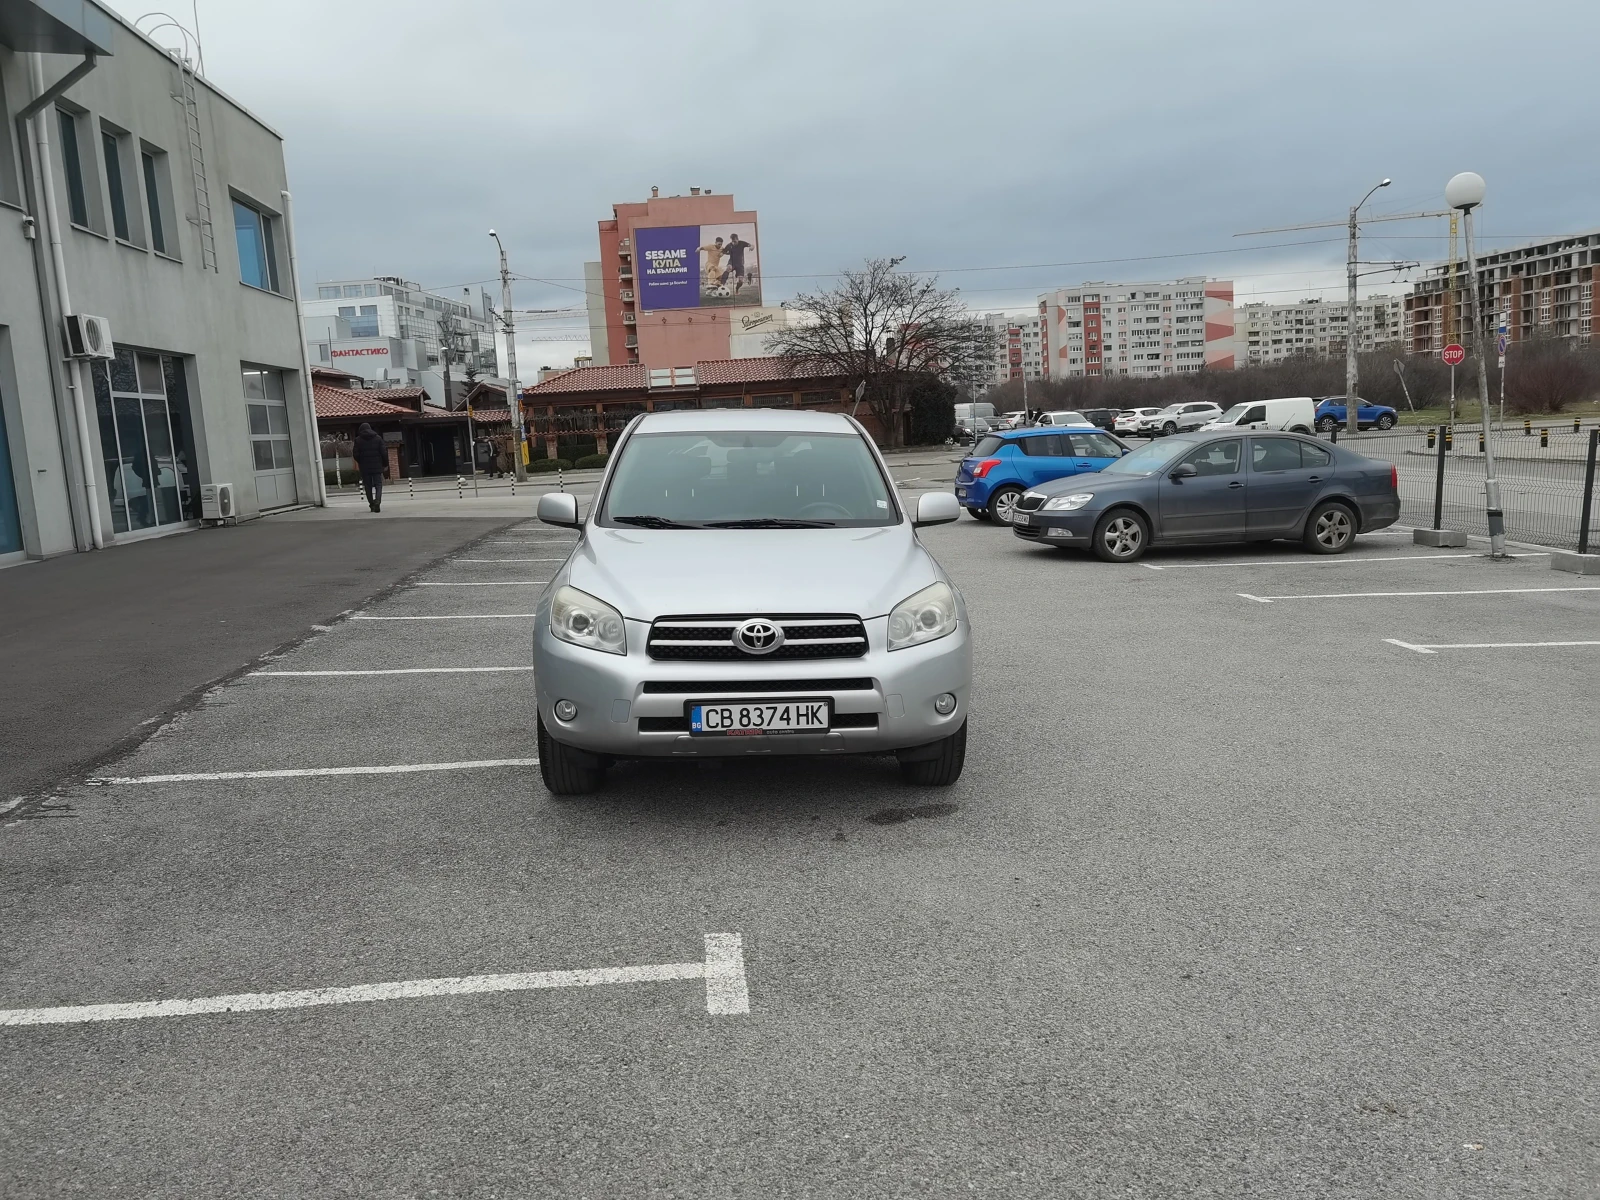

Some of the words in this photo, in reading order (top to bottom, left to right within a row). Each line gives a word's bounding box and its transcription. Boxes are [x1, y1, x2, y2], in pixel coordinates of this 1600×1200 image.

[645, 249, 687, 260] SESAME
[652, 259, 681, 268] КУПА
[331, 347, 389, 358] ФАНТАСТИКО
[1444, 350, 1463, 359] STOP
[705, 708, 734, 729] CB
[738, 705, 792, 728] 8374
[796, 704, 824, 726] HK
